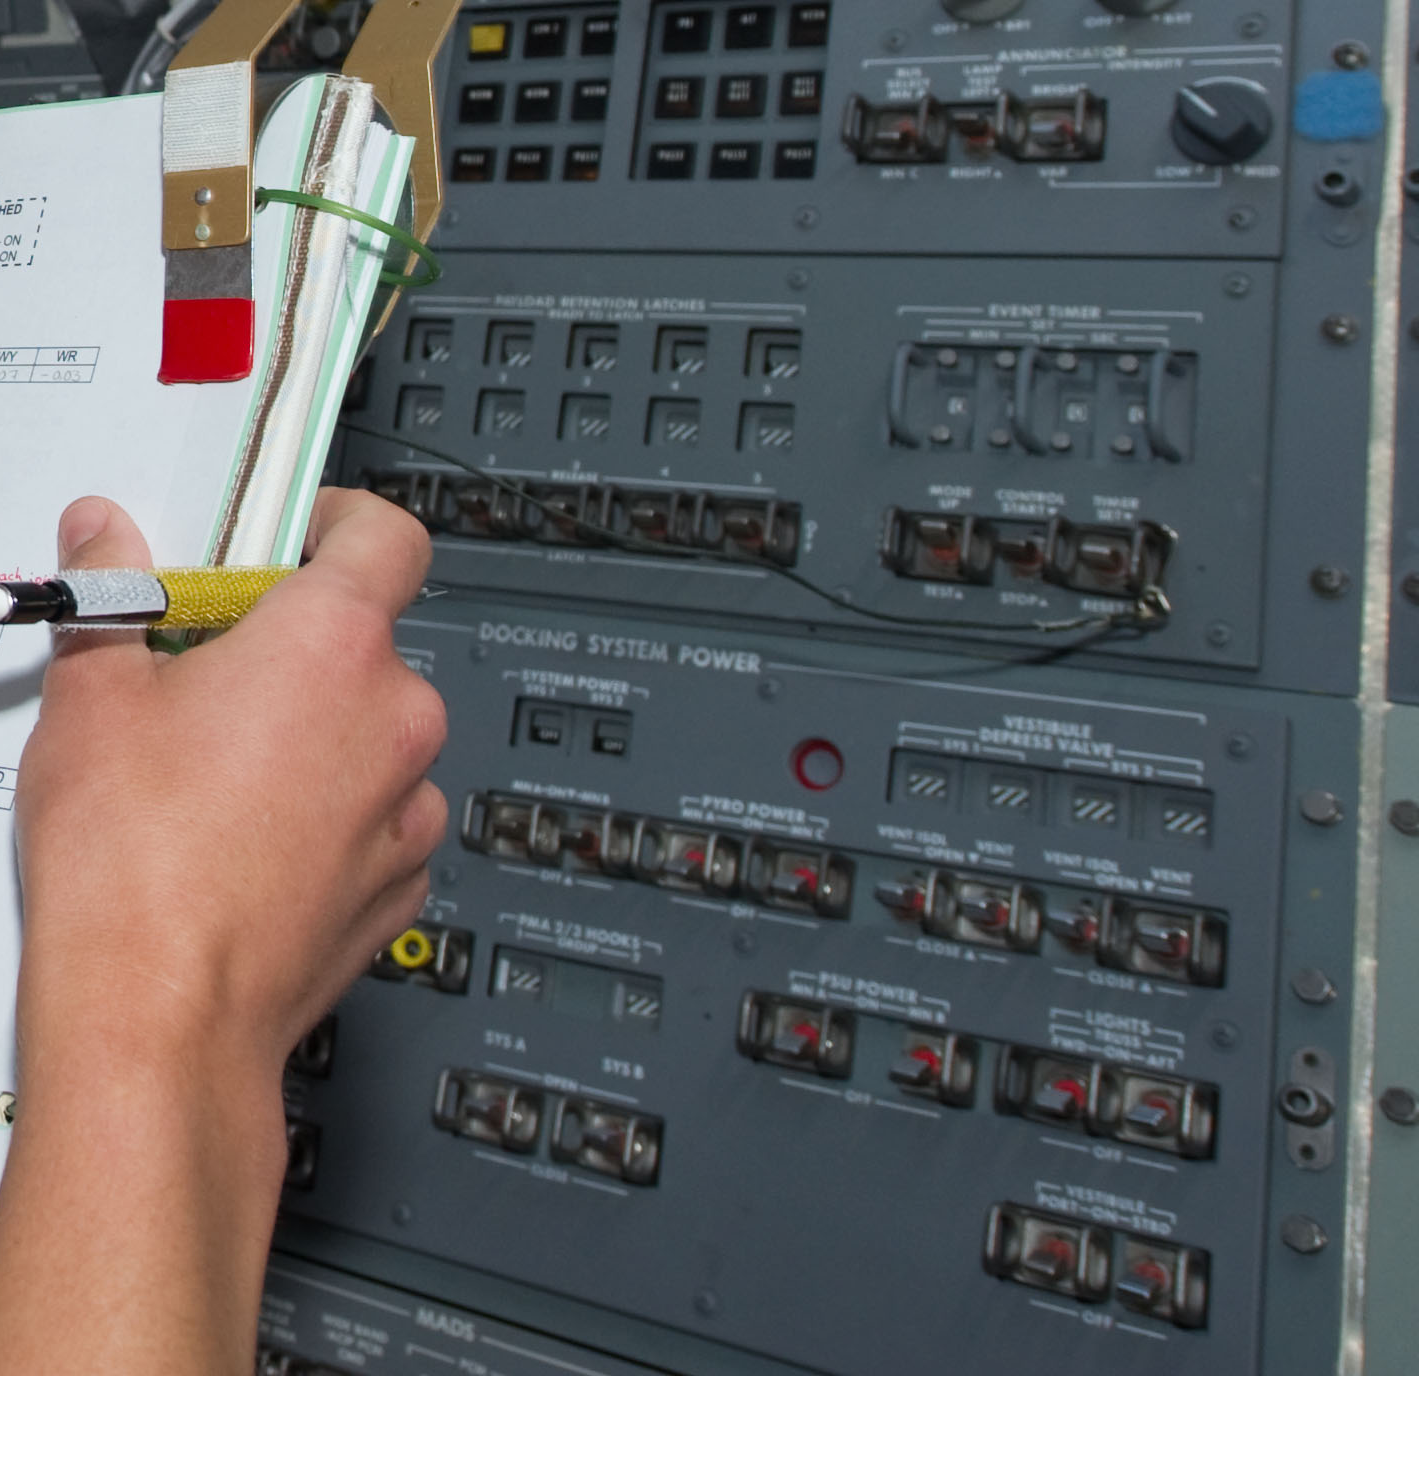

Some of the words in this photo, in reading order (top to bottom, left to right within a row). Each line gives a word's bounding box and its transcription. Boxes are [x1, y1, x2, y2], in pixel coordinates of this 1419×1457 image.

[988, 304, 1043, 318] EVENT
[1048, 305, 1101, 319] TIMER
[480, 622, 577, 651] DOCKING
[587, 634, 667, 662] SYSTEM
[678, 646, 760, 674] POWER
[521, 669, 574, 688] SYSTEM
[578, 676, 629, 695] POWER
[1004, 716, 1093, 740] VESTIBULE
[979, 728, 1053, 751] DEPRESS
[1058, 739, 1115, 758] VALVE
[702, 796, 744, 814] PYRO
[749, 802, 806, 822] POWER
[877, 825, 913, 840] VENT
[1085, 1009, 1152, 1033] LIGHTS
